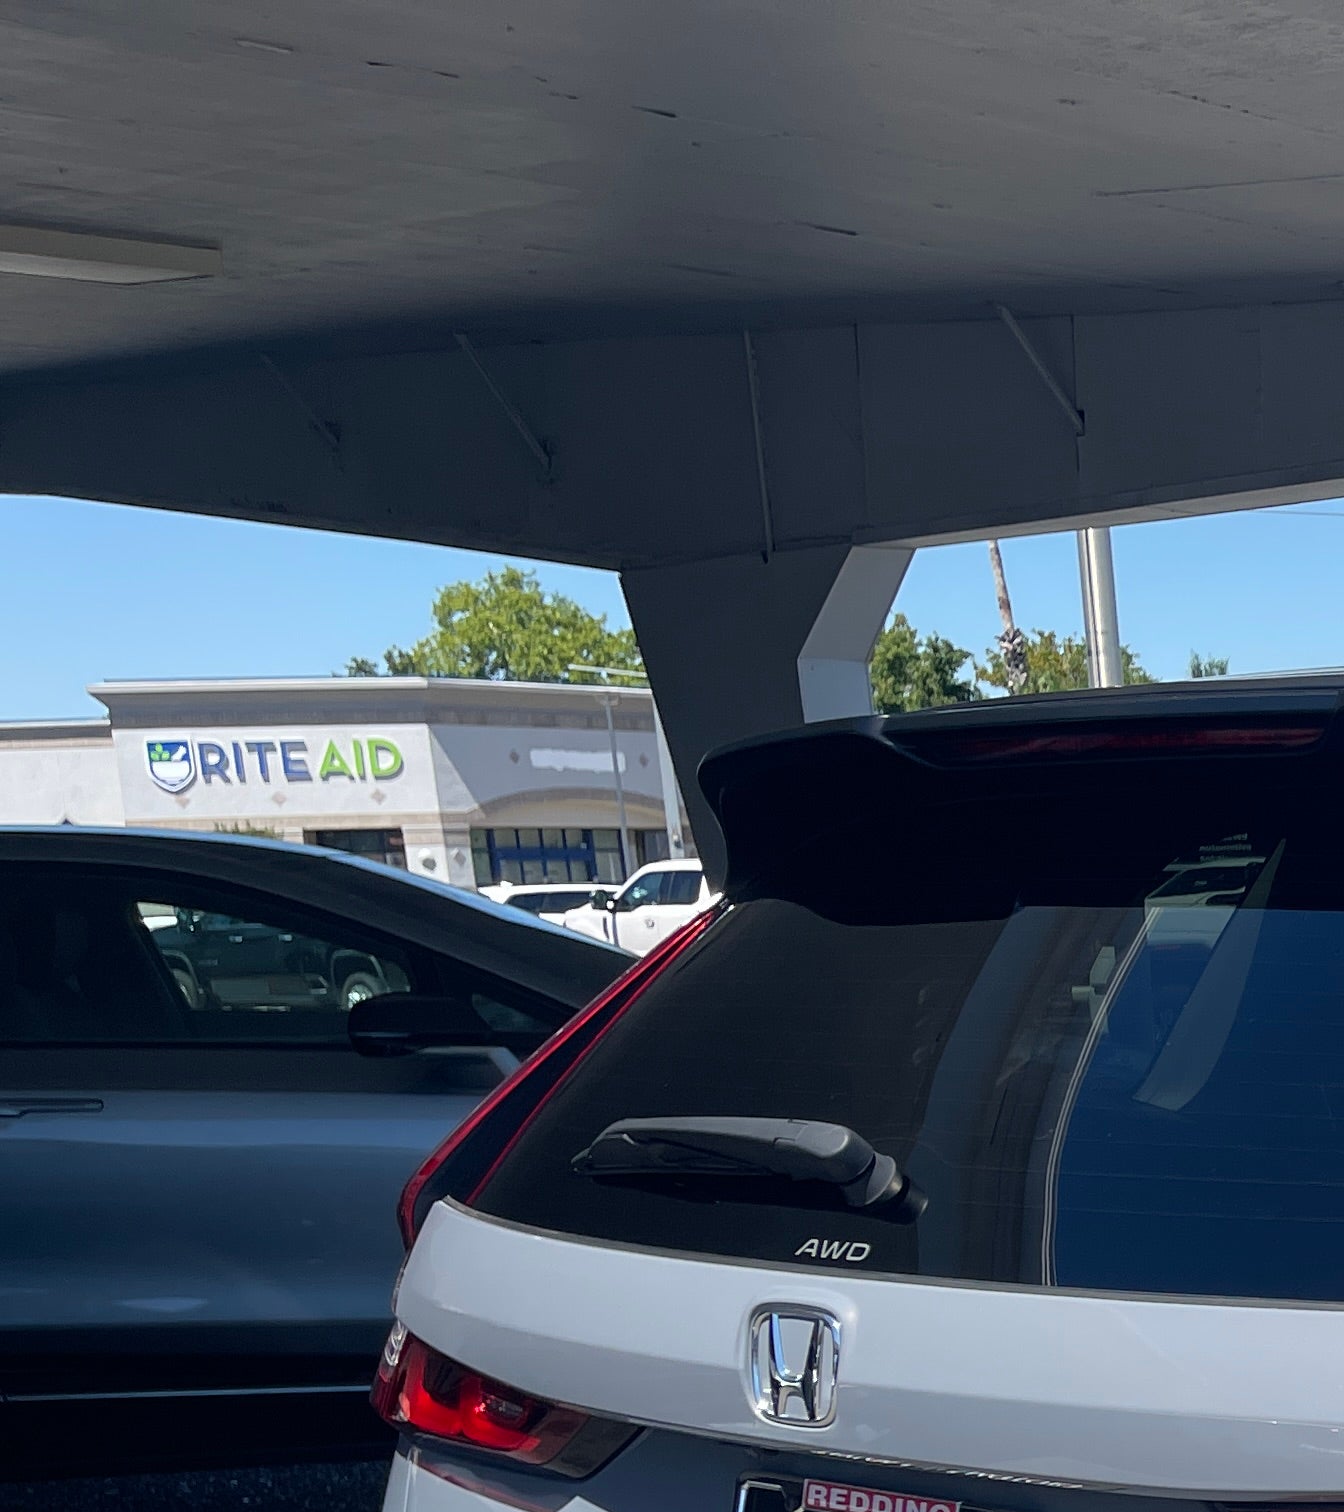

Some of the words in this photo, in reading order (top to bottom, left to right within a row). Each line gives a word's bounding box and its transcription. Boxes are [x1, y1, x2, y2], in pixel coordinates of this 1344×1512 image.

[197, 739, 313, 785] RITE
[319, 737, 404, 783] AID
[794, 1237, 871, 1262] AWD
